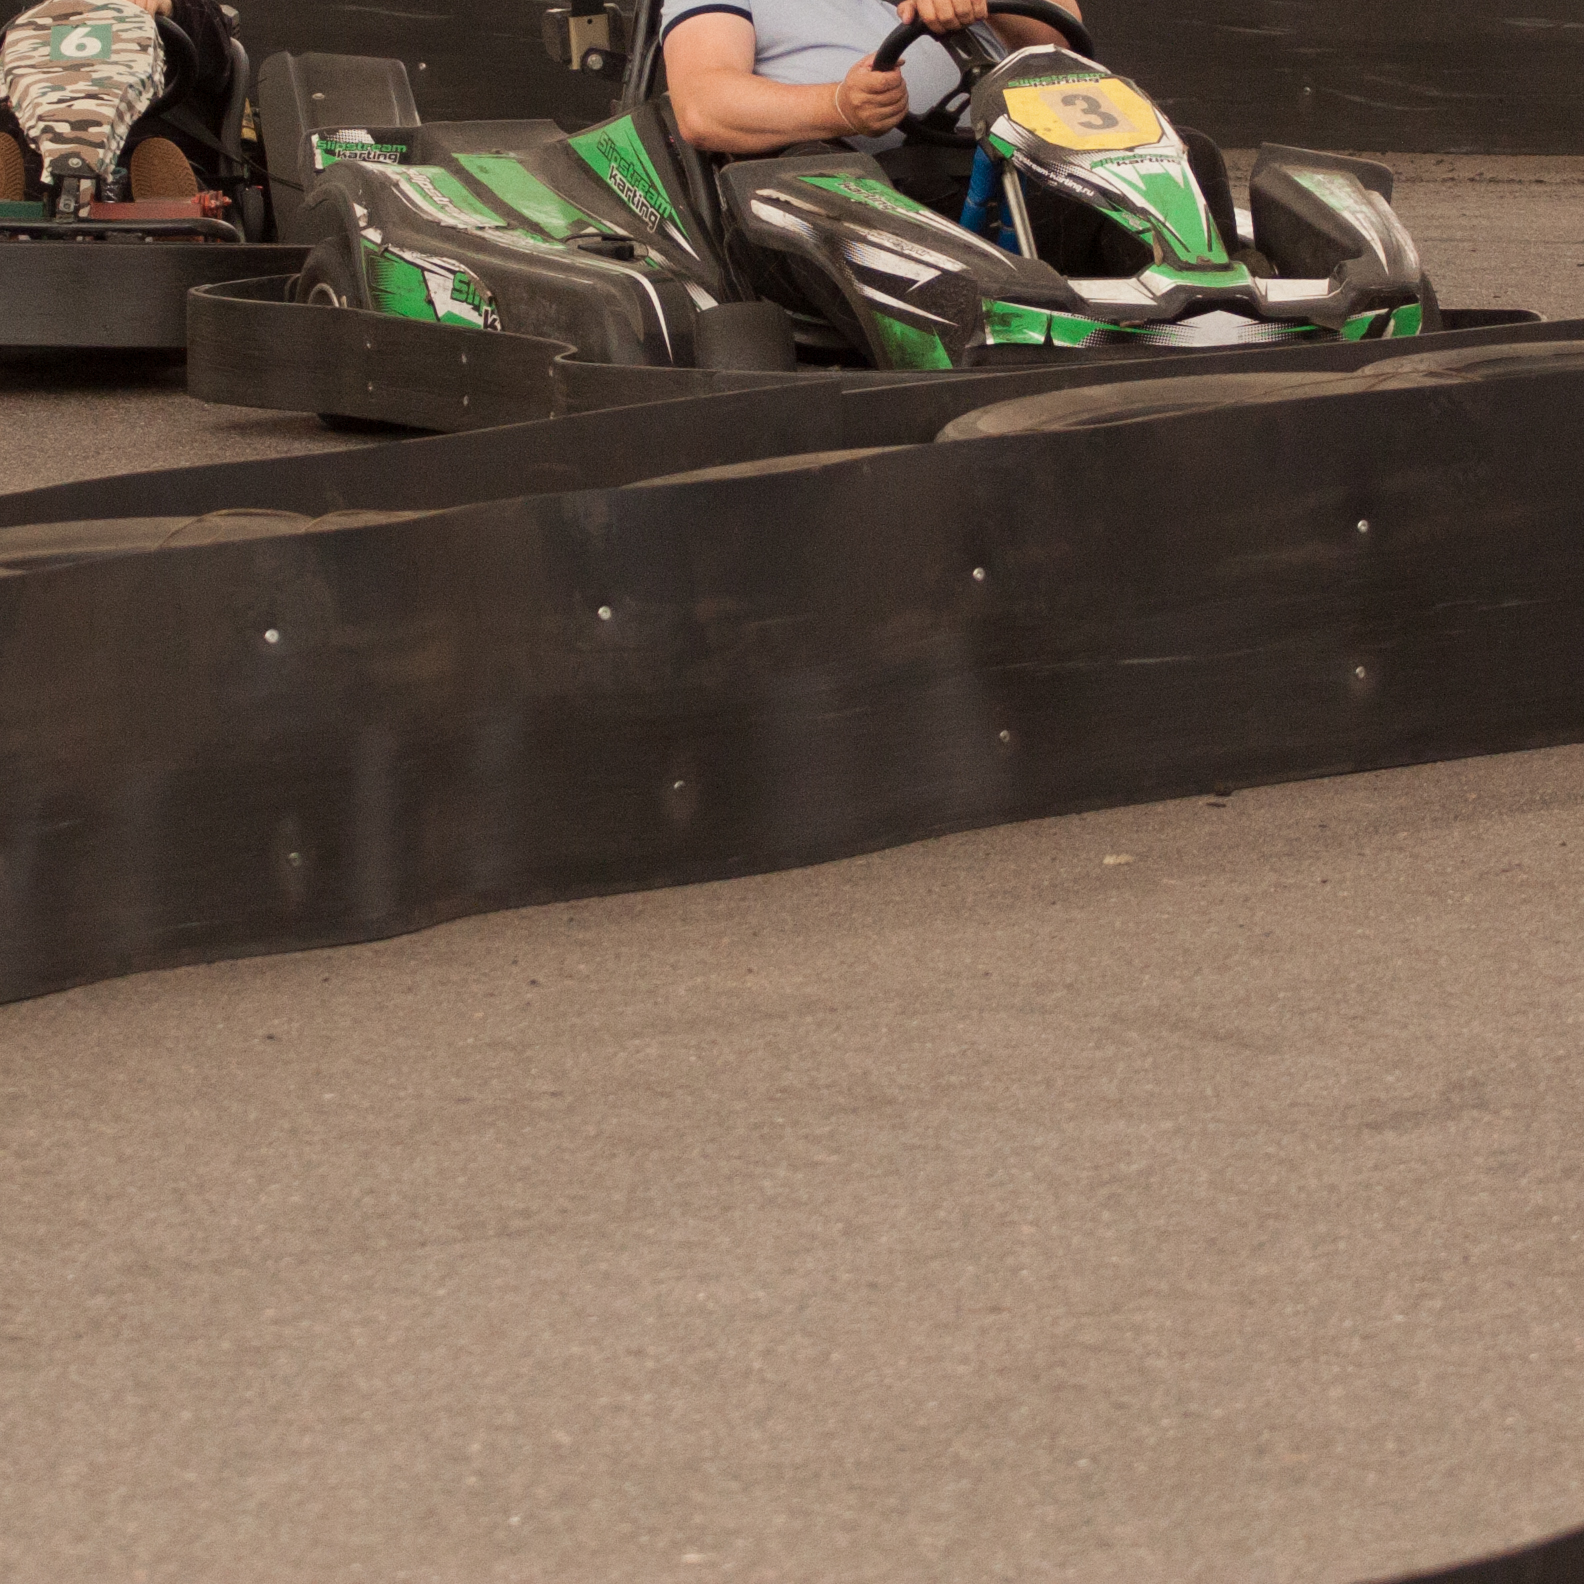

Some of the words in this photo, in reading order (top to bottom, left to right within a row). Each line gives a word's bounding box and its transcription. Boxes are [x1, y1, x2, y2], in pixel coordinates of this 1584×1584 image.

[60, 27, 102, 57] 6
[1061, 94, 1119, 130] 3
[317, 140, 407, 153] Slipstream
[336, 149, 400, 165] karting
[1091, 153, 1185, 170] Slipstre
[596, 131, 672, 219] Slipstream
[607, 163, 661, 234] karting
